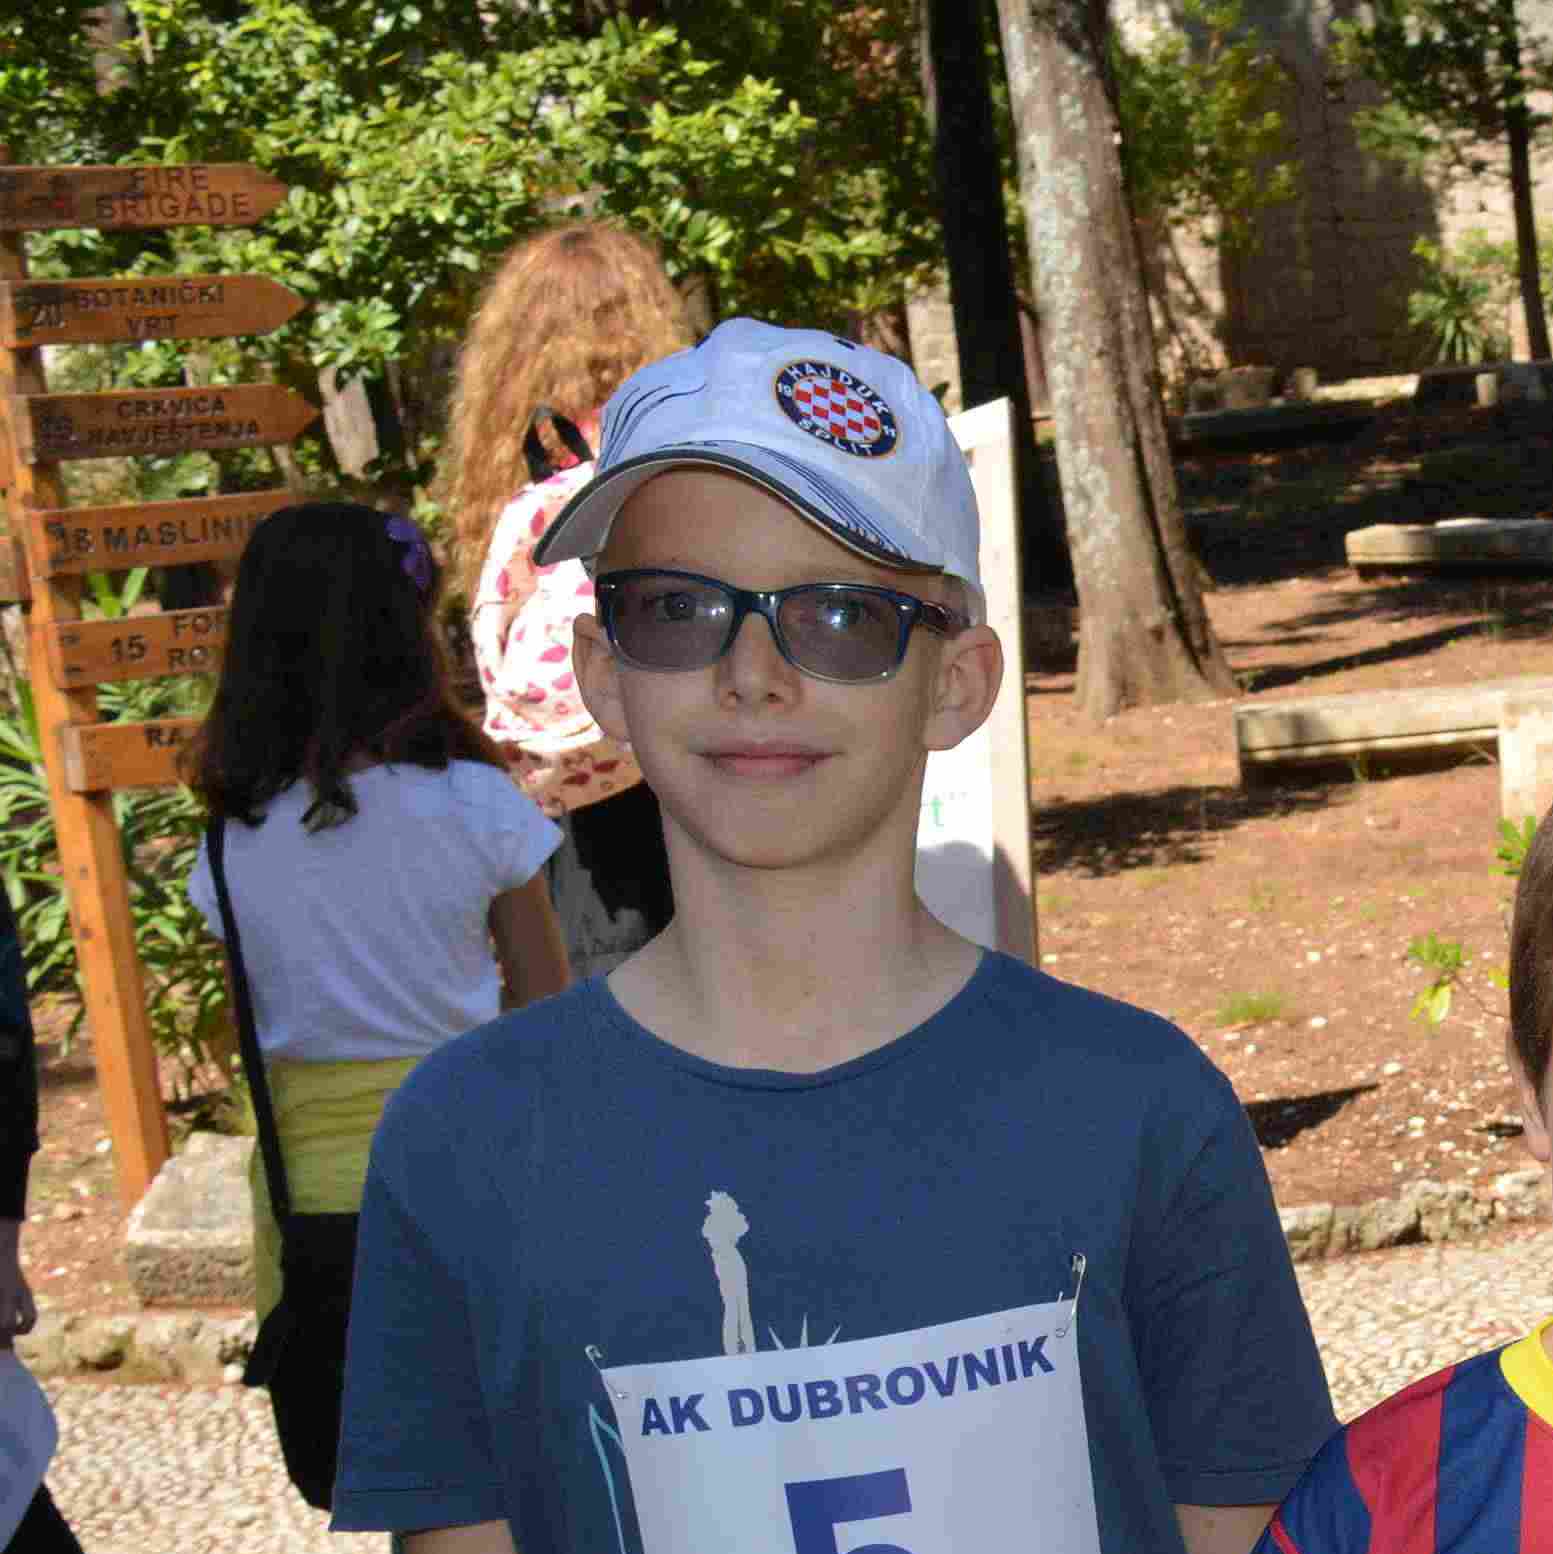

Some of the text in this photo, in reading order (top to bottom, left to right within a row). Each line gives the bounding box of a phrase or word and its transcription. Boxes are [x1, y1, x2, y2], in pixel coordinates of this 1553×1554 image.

[131, 167, 208, 191] FIRE
[97, 192, 252, 220] BRIGADE
[785, 362, 889, 414] HAJDUK
[799, 418, 873, 455] SPLIT
[110, 634, 147, 662] 15
[641, 1334, 1056, 1436] AK DUBROVNIK
